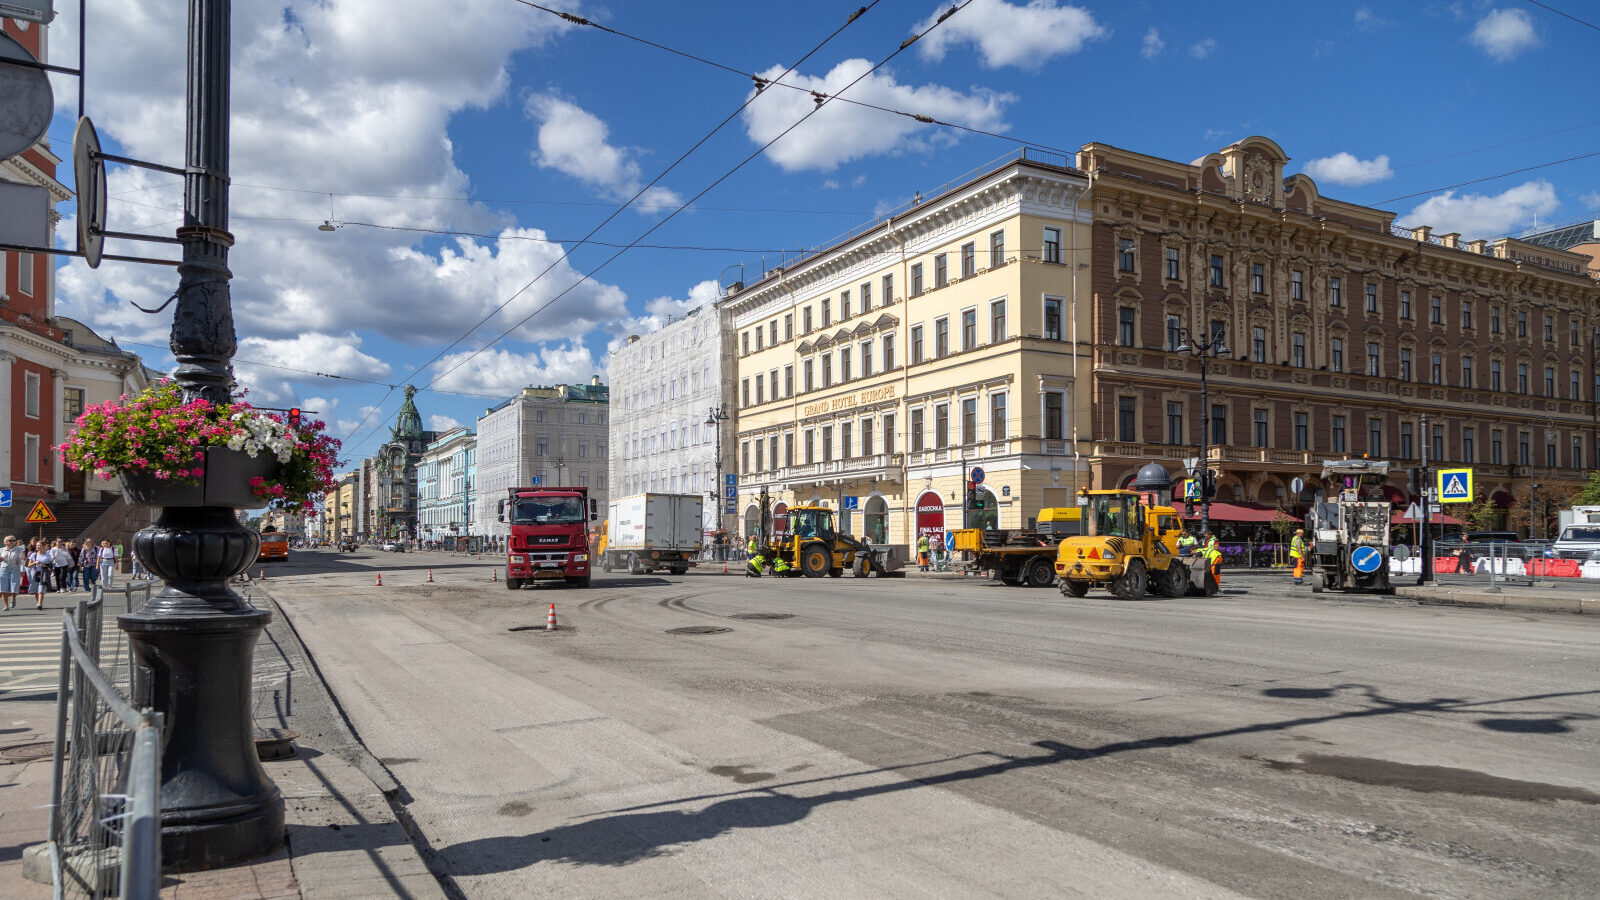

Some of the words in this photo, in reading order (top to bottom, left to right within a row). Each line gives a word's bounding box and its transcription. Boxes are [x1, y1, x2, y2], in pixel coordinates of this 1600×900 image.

[804, 402, 829, 417] GRAND
[832, 395, 858, 410] HOTEL
[861, 386, 895, 404] EUROPE
